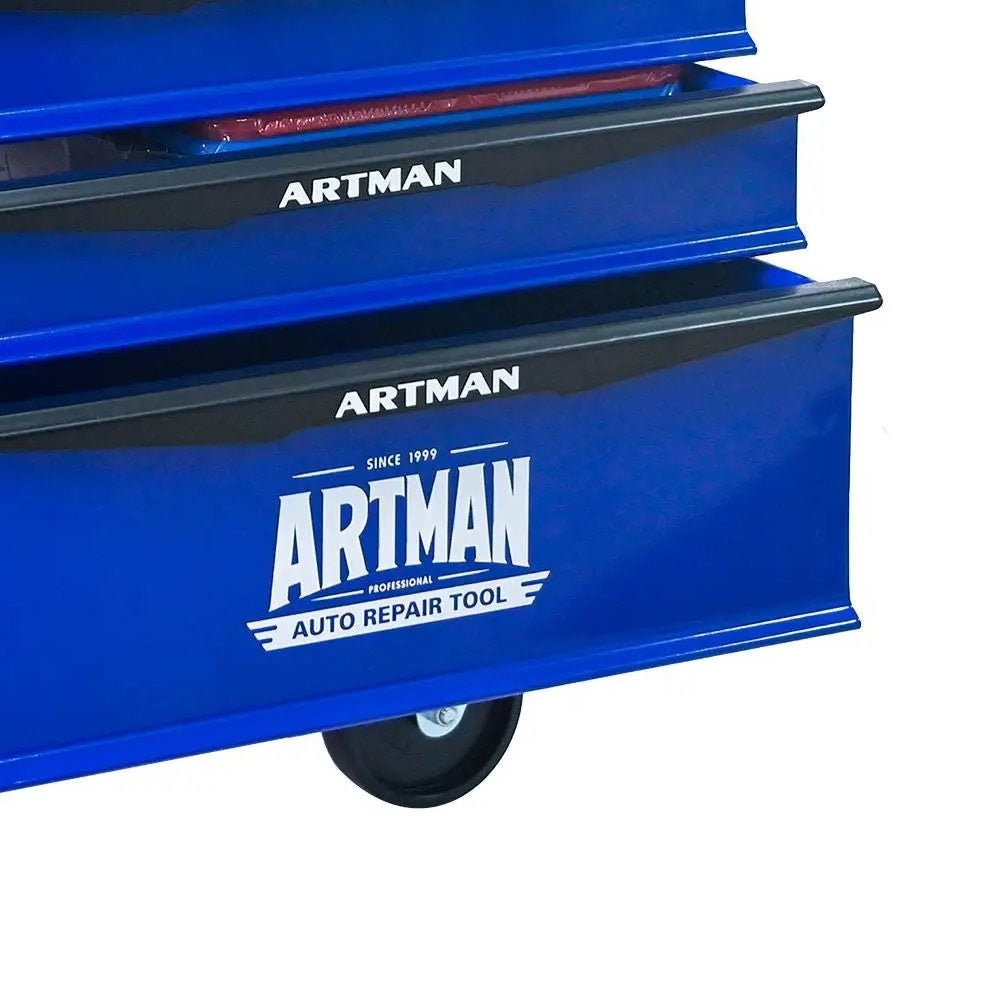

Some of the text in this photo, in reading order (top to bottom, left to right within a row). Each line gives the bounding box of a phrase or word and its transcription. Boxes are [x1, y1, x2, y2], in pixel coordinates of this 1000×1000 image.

[279, 159, 461, 208] ARTMAN
[336, 366, 519, 418] ARTMAN
[366, 448, 438, 470] SINCE 1999
[268, 456, 531, 613] ARTMAN
[368, 575, 433, 594] PROFESSIONAL
[292, 586, 507, 640] AUTO REPAIR TOOL
